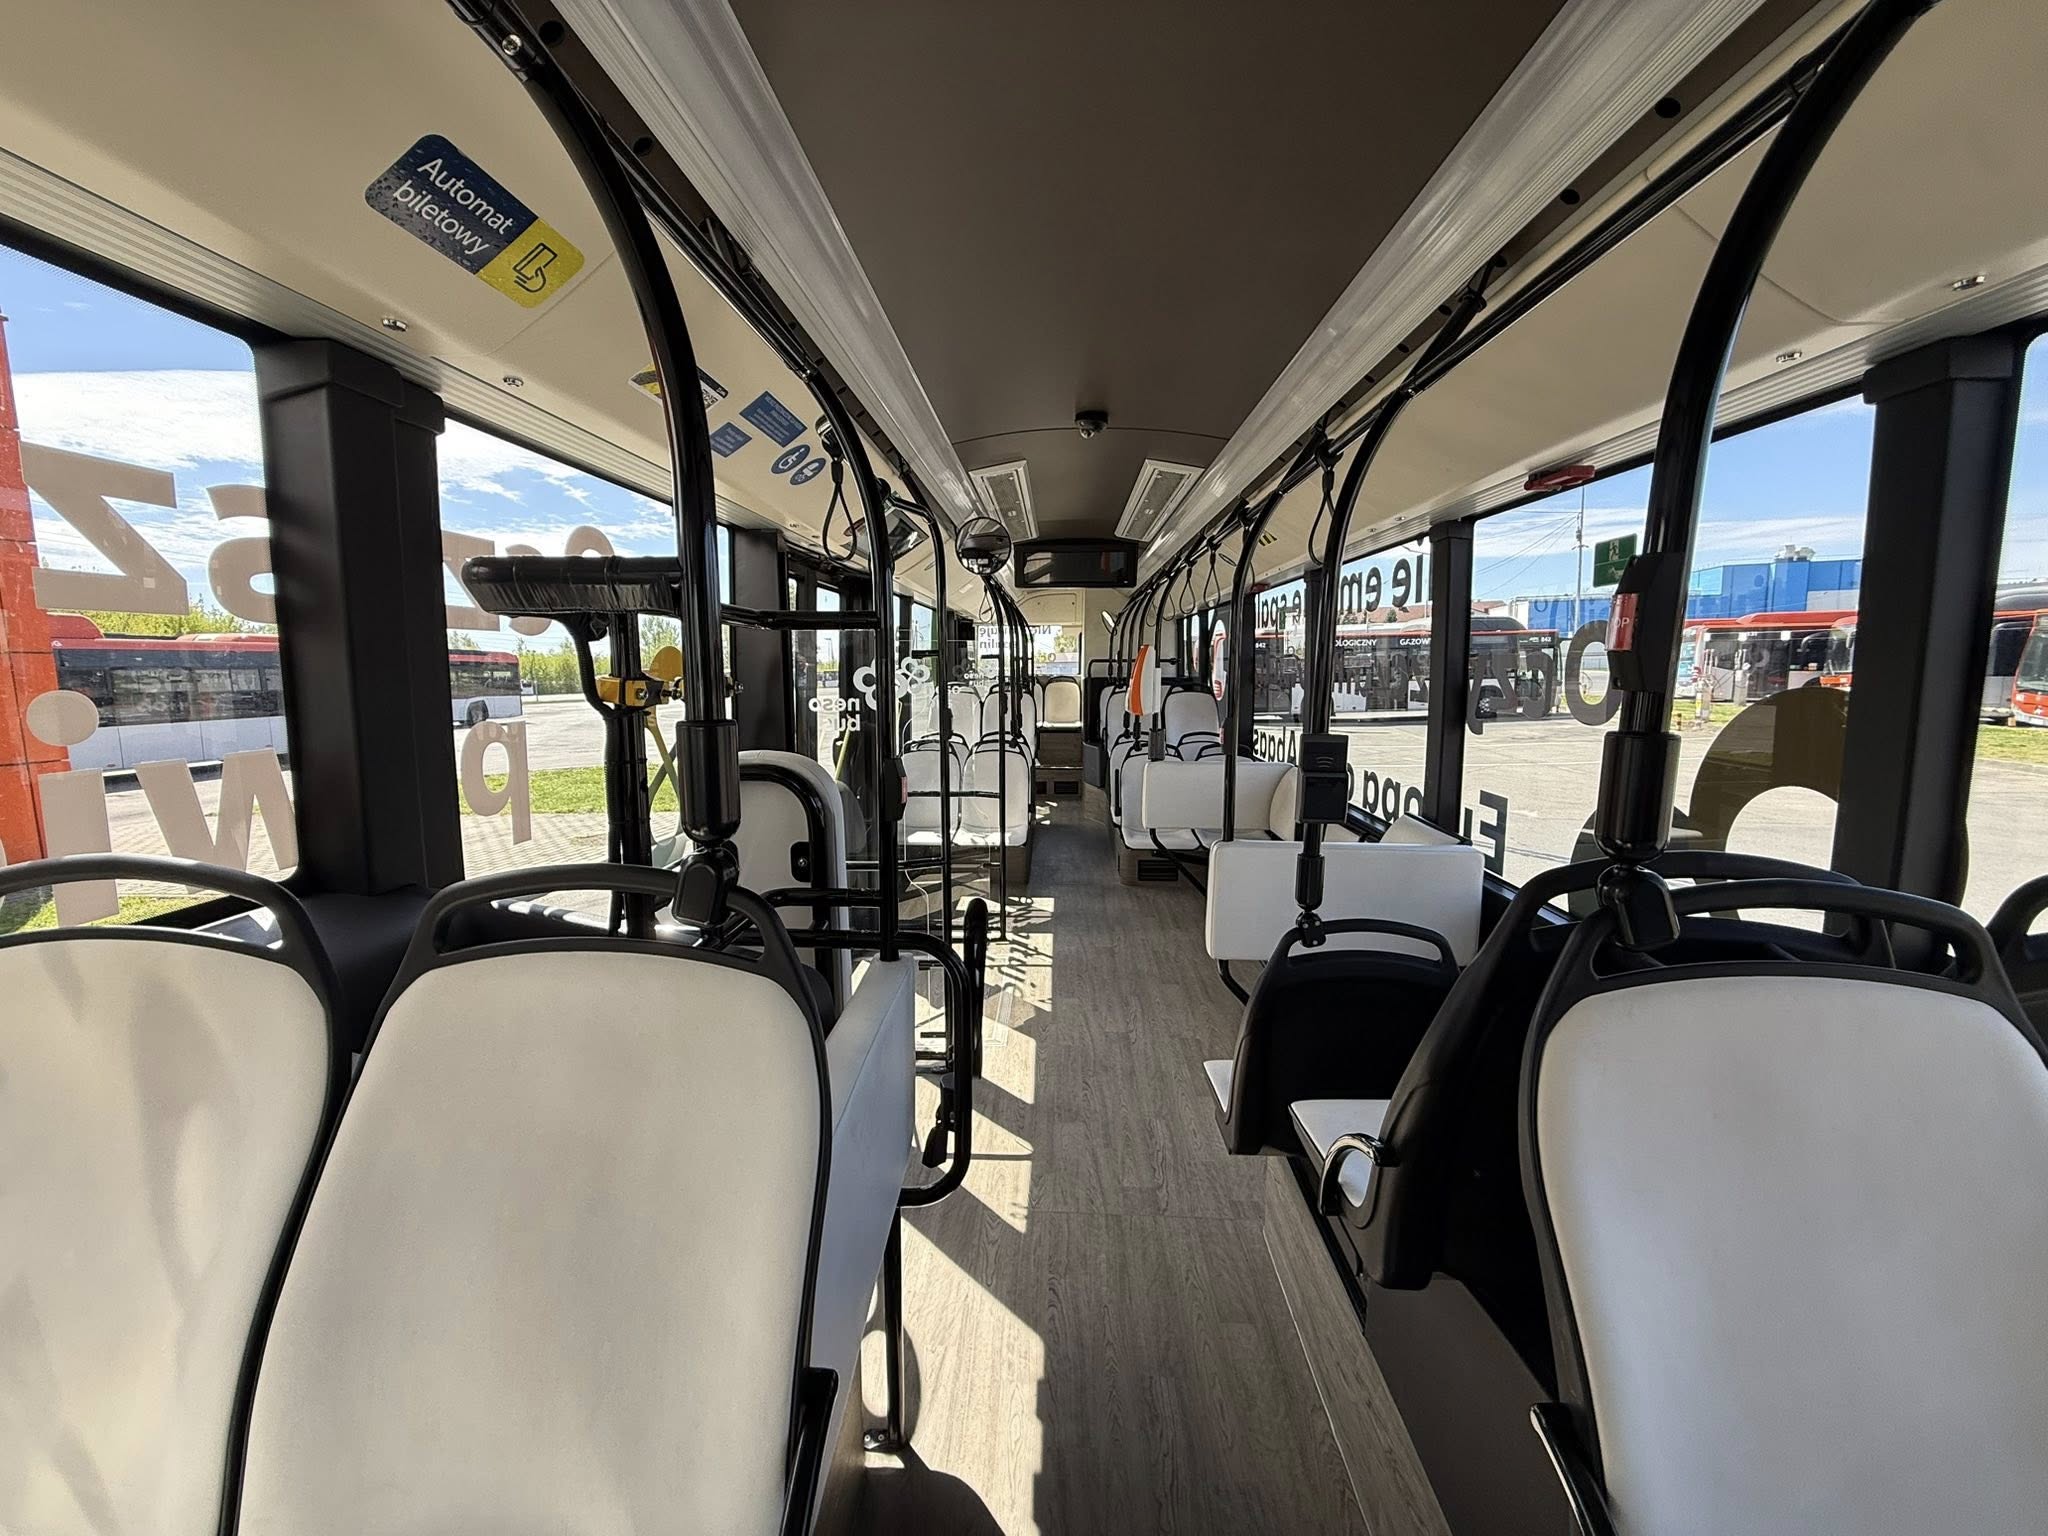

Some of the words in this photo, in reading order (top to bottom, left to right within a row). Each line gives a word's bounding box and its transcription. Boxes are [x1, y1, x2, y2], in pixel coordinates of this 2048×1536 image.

[392, 180, 490, 255] biletowy
[417, 158, 513, 235] Automat
[1400, 638, 1431, 646] GAZOW
